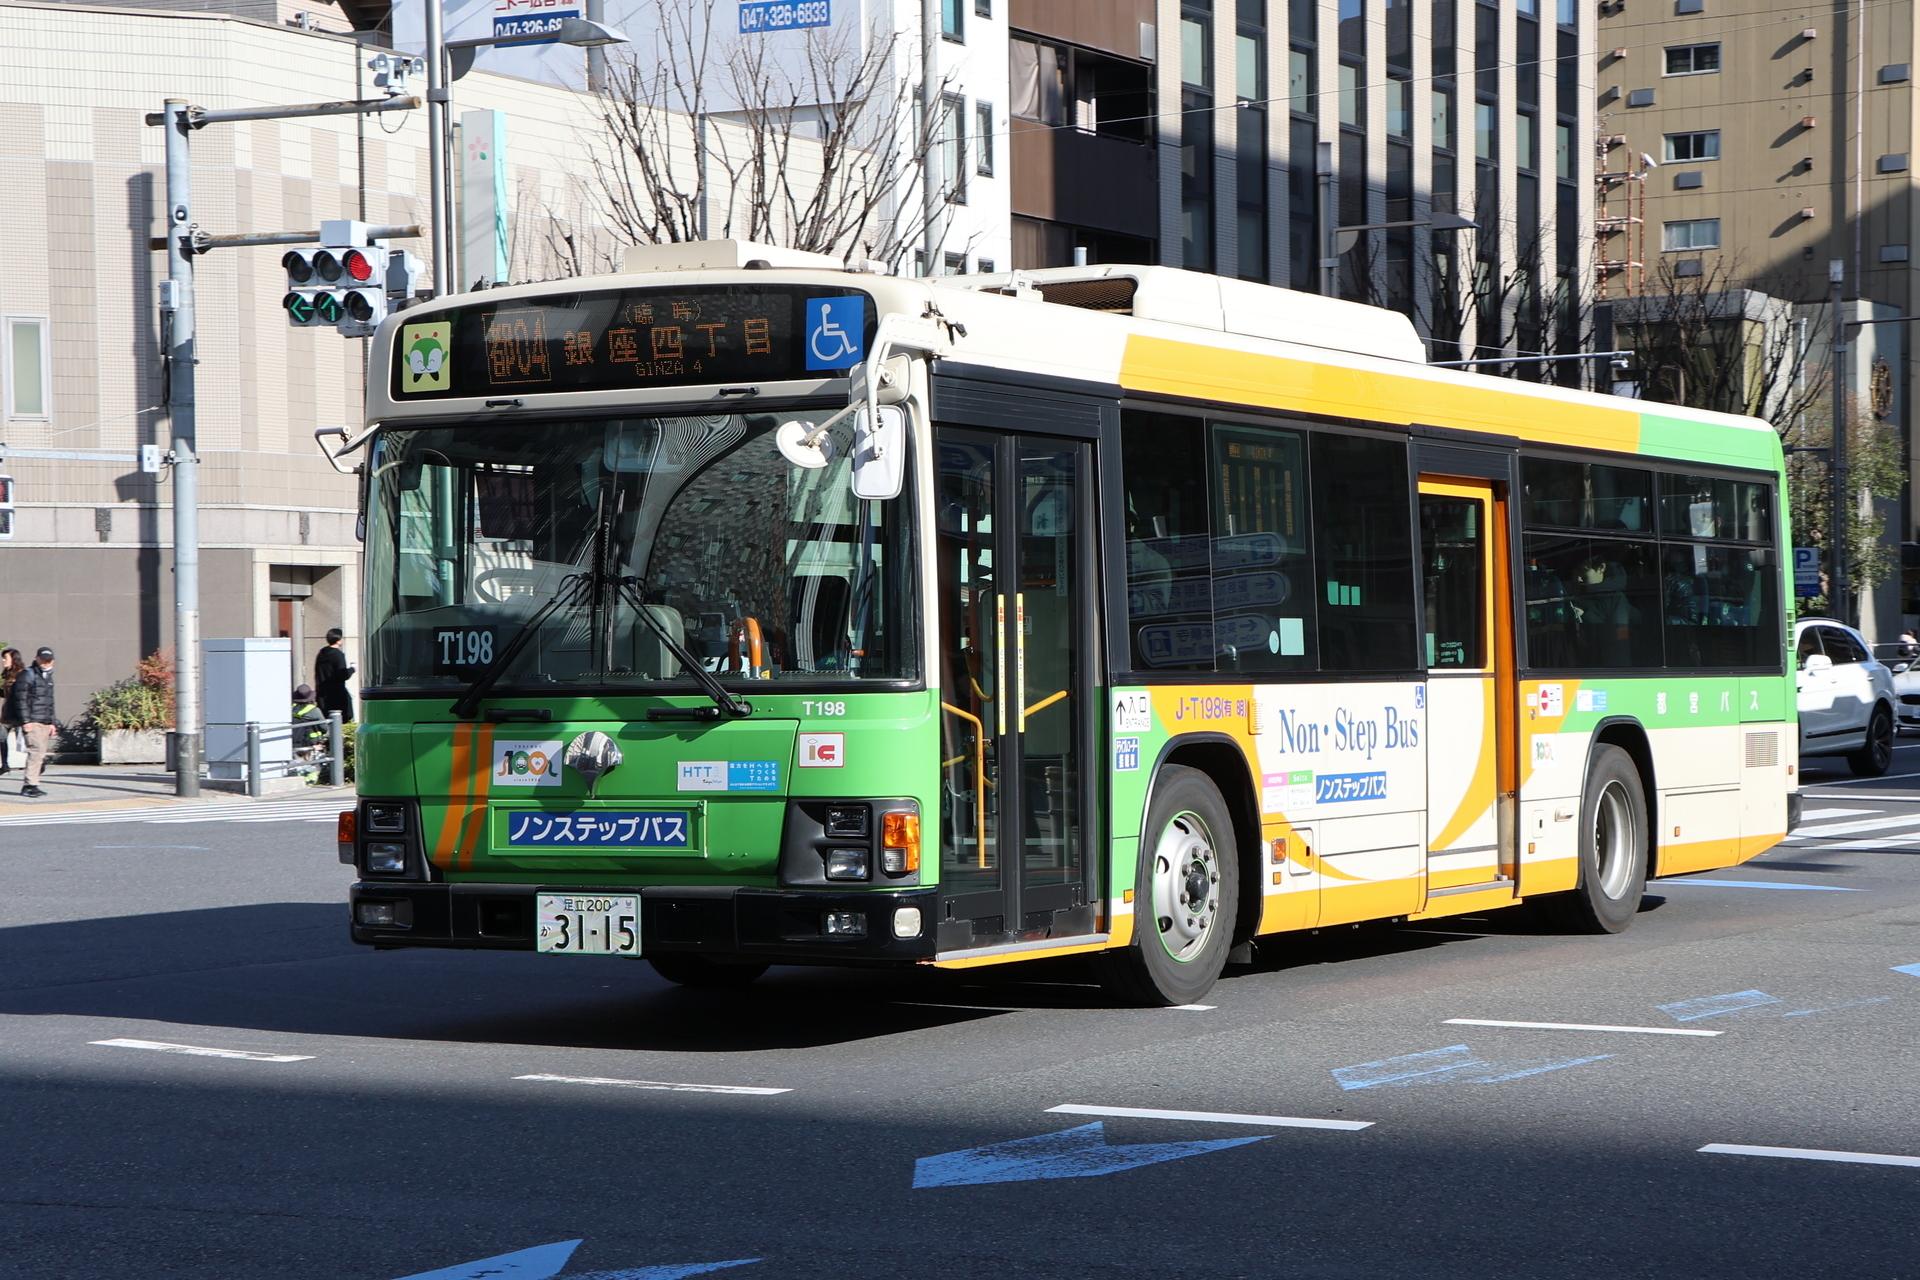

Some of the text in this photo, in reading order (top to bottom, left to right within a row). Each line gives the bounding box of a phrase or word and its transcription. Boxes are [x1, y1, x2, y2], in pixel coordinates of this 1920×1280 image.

[563, 318, 771, 366] 銀座四丁目
[635, 359, 703, 376] GINZA 4
[1796, 550, 1811, 569] P
[438, 631, 493, 664] T198
[802, 701, 846, 716] T198
[1384, 706, 1419, 748] Bus
[683, 766, 713, 777] HTT
[1317, 775, 1386, 800] ノンステップバス
[511, 816, 686, 842] ノンステップバス
[541, 925, 552, 937] か
